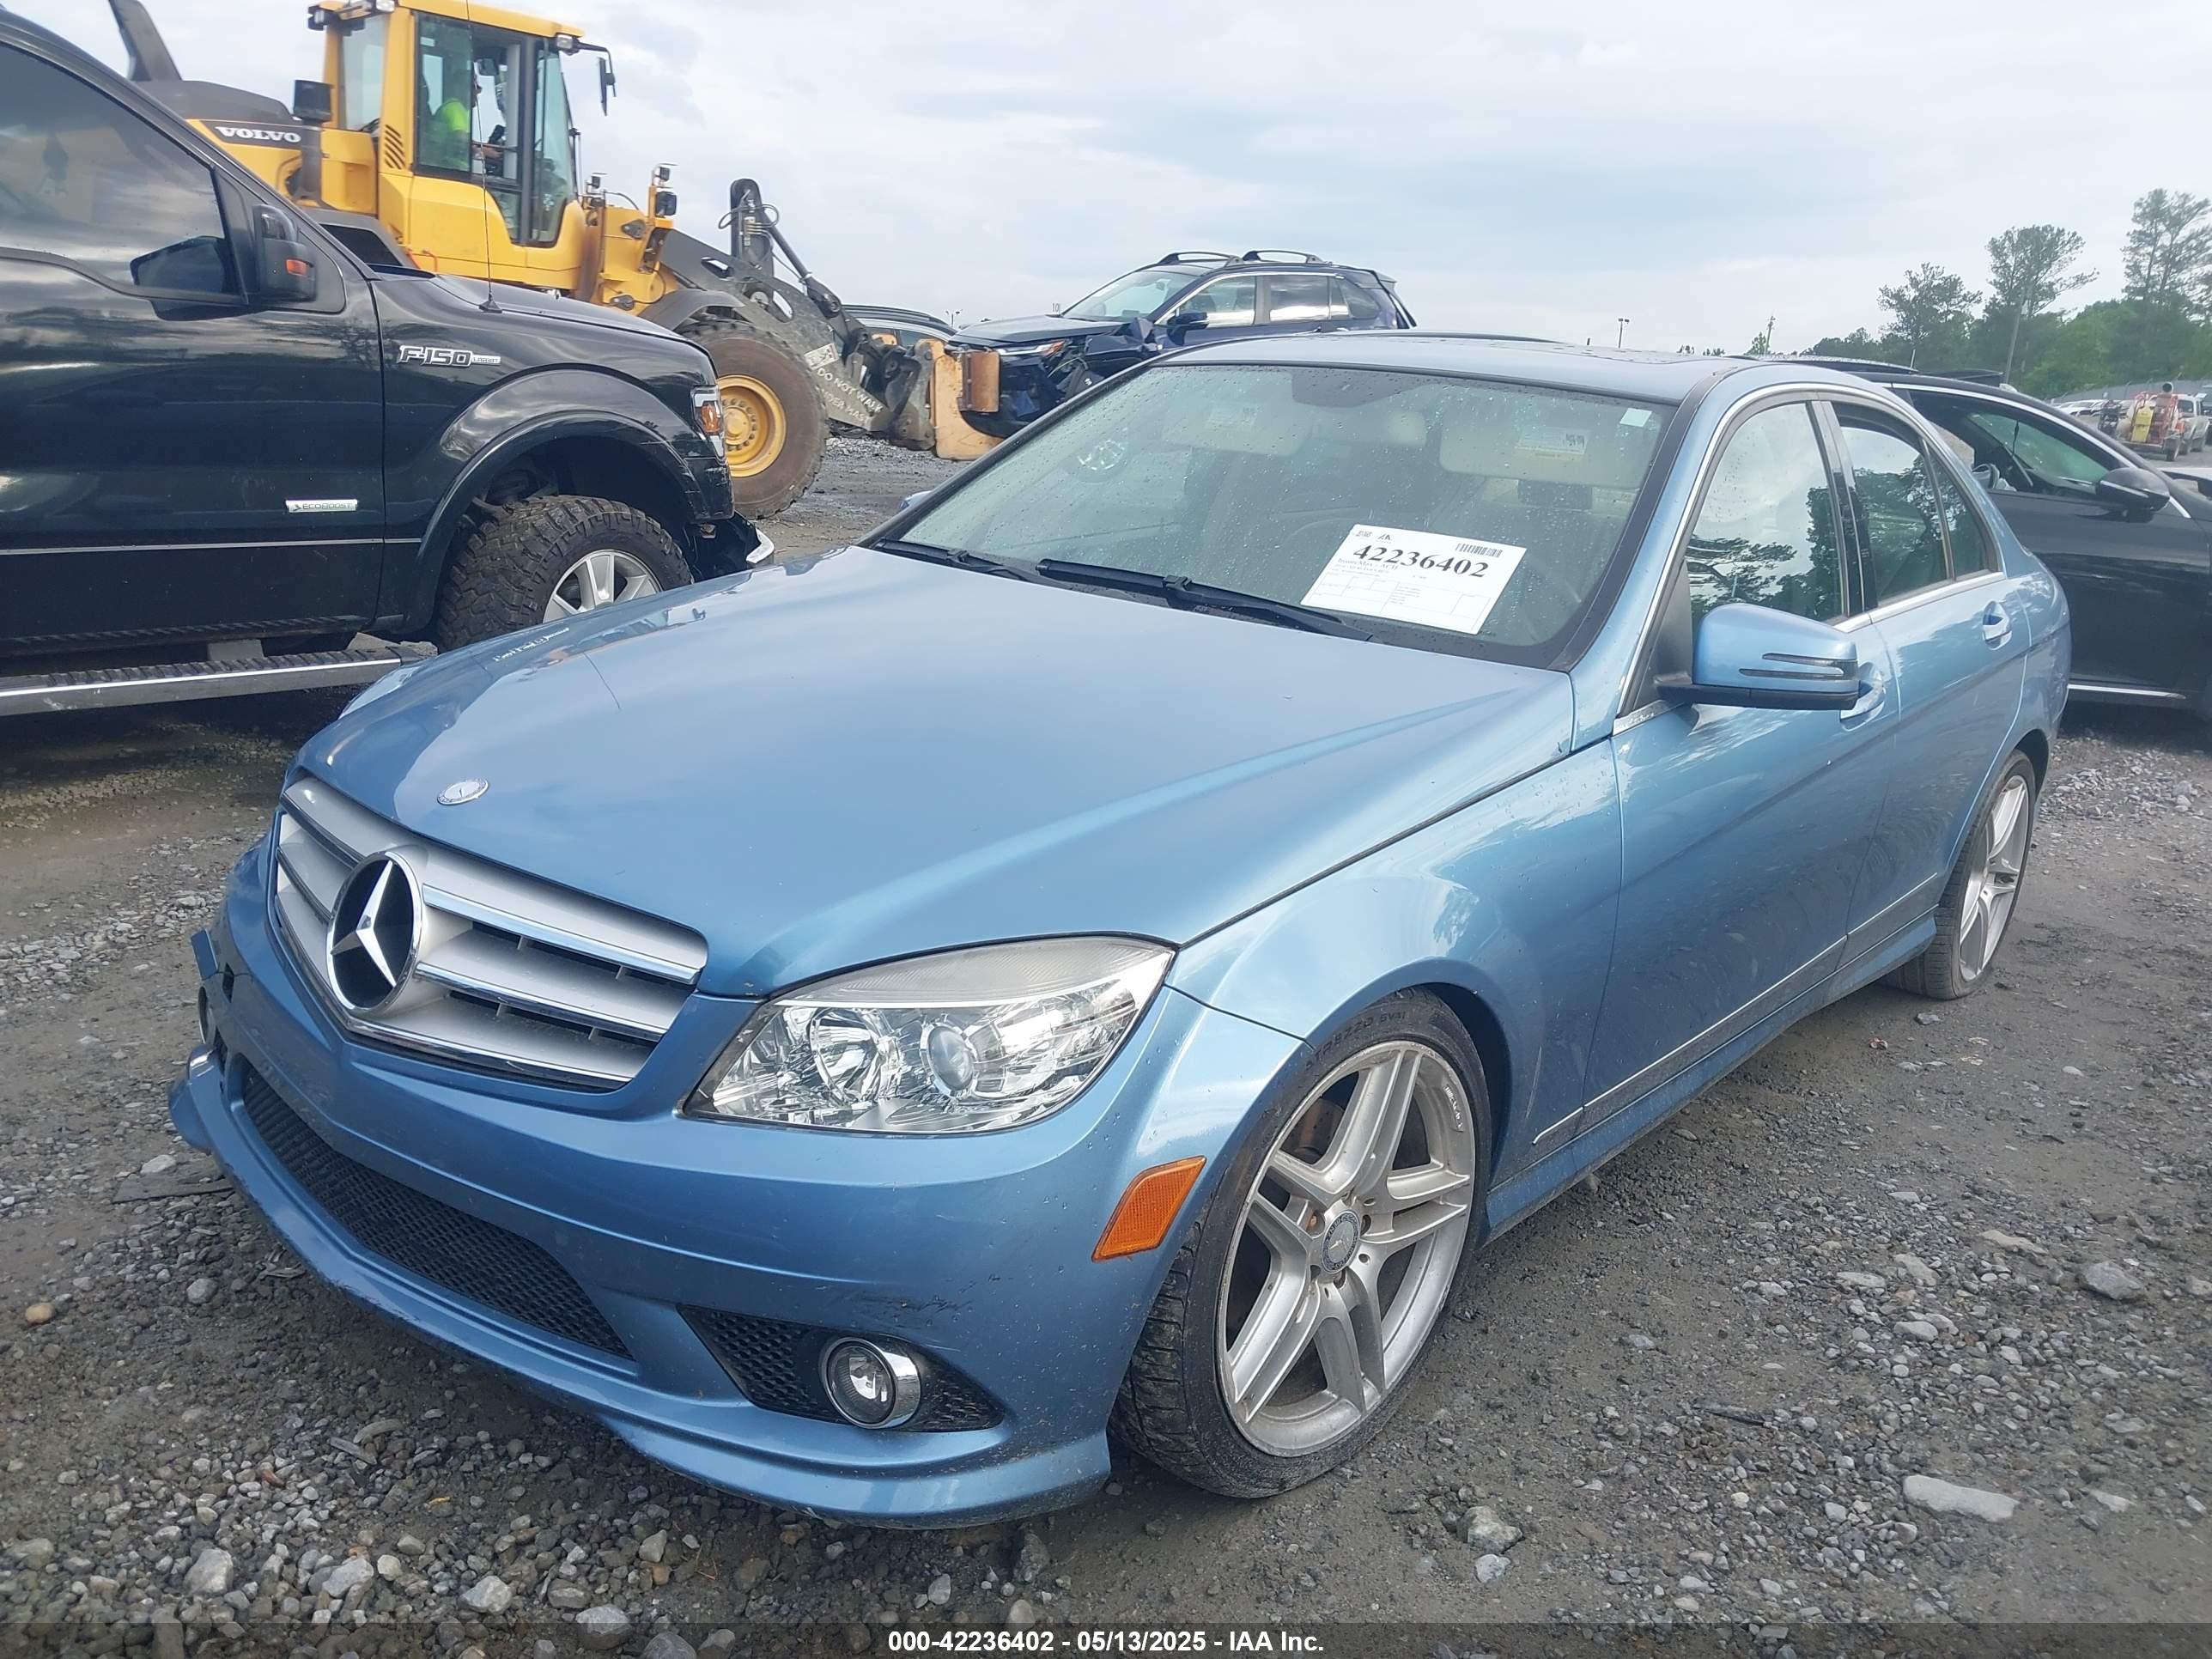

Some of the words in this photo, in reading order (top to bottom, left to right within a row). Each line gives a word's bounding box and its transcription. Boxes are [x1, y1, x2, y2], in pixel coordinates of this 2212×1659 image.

[215, 126, 301, 143] VOLVO
[397, 345, 471, 367] F-150
[817, 368, 833, 381] DO
[834, 378, 855, 395] NOT
[857, 391, 884, 413] WALK
[1353, 545, 1488, 578] 42236402
